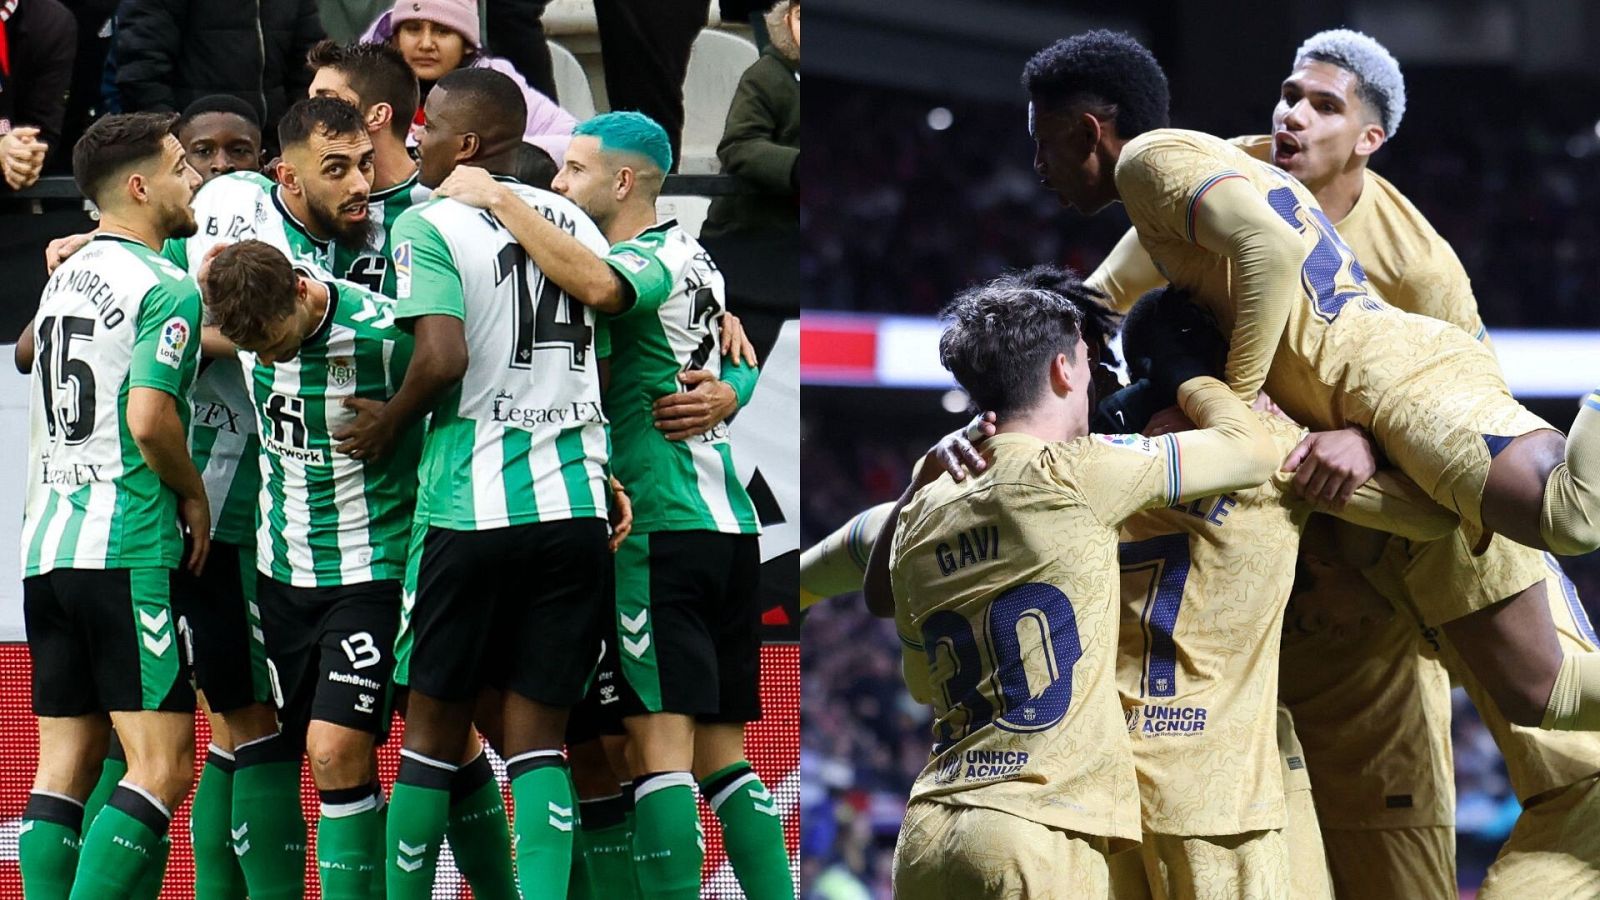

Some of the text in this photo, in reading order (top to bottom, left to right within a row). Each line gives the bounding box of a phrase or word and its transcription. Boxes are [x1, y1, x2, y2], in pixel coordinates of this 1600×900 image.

[64, 269, 125, 330] MORENO
[493, 242, 593, 372] 14
[35, 315, 96, 447] 15
[266, 439, 321, 463] network
[935, 526, 999, 577] GAVI
[1118, 532, 1190, 699] 7
[328, 670, 381, 691] MuchBetter
[1143, 704, 1207, 721] UNHCR
[1142, 719, 1205, 733] ACNUR
[965, 750, 1029, 765] UNHCR
[964, 764, 1024, 778] ACNUR
